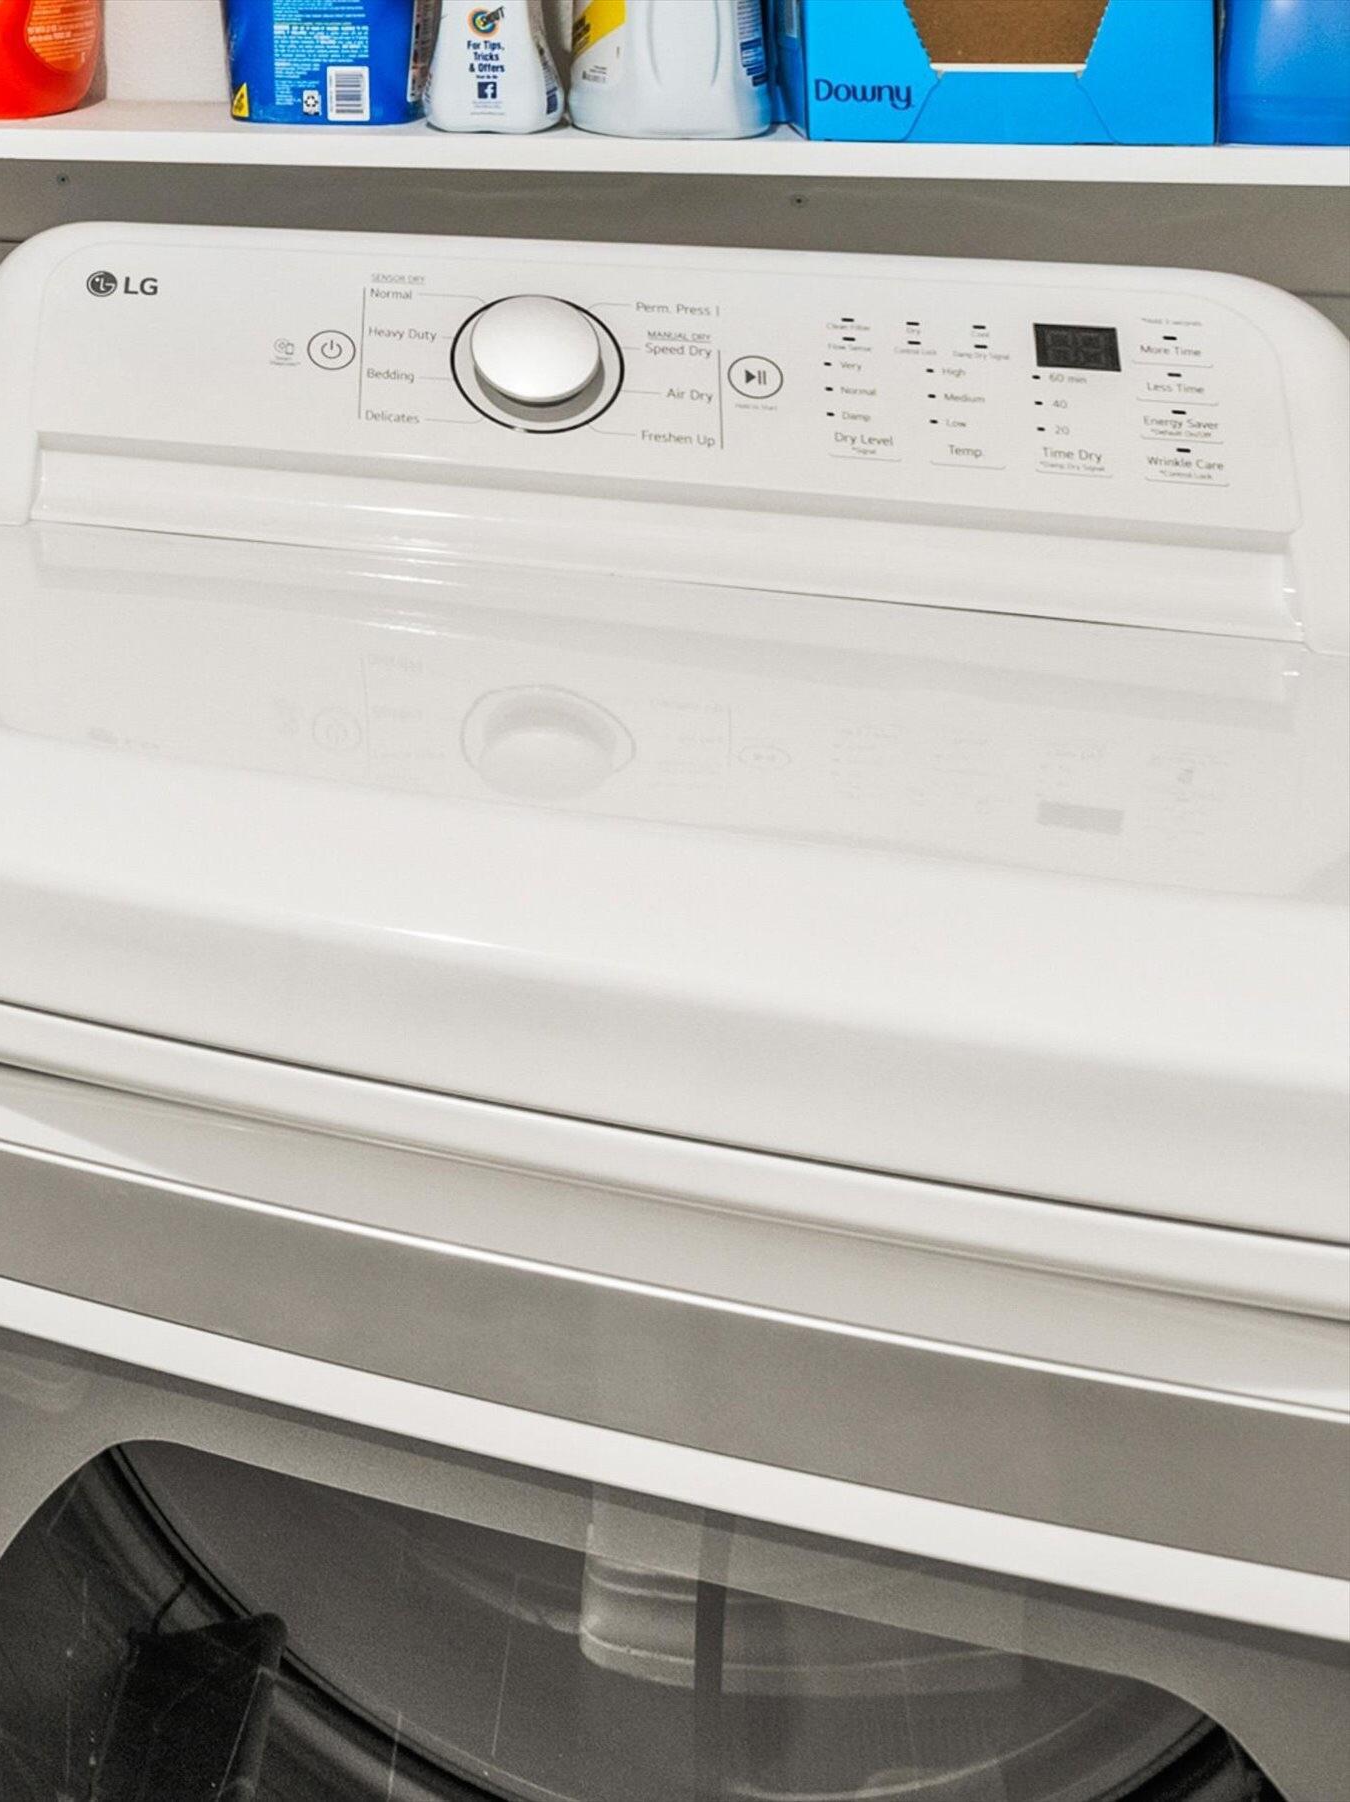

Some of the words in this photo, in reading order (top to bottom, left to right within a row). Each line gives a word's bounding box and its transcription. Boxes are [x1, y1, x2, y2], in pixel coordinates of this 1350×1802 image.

[467, 41, 480, 50] For
[484, 41, 505, 51] Tips,
[473, 52, 499, 61] Tricks
[469, 63, 475, 73] &
[478, 63, 505, 73] Offers
[814, 78, 912, 111] Downy
[123, 276, 159, 296] LG
[408, 275, 425, 285] DRY
[370, 288, 413, 300] Normal
[635, 301, 671, 314] Perm.
[676, 303, 710, 316] Press
[368, 326, 403, 340] Heavy
[408, 328, 437, 342] Duty
[647, 330, 689, 341] MANUAL
[692, 333, 712, 342] DRY
[906, 327, 920, 335] Dry
[645, 342, 684, 356] Speed
[689, 344, 712, 359] Dry
[1140, 345, 1169, 355] More
[1174, 346, 1201, 357] Time
[841, 360, 862, 371] Very
[366, 368, 415, 383] Bedding
[942, 367, 966, 378] High
[1049, 374, 1065, 383] 60
[1067, 375, 1087, 384] min
[841, 386, 877, 396] Normal
[1147, 382, 1173, 393] Less
[1177, 383, 1204, 394] Time
[666, 388, 685, 399] Air
[690, 389, 714, 404] Dry
[944, 393, 986, 404] Medium
[1052, 400, 1068, 409] 40
[365, 410, 420, 424] Delicates
[842, 411, 871, 423] Damp
[946, 418, 967, 428] Low
[1143, 416, 1182, 429] Energy
[1186, 418, 1219, 430] Saver
[1054, 426, 1070, 435] 20
[641, 430, 692, 444] Freshen
[697, 434, 716, 448] Up
[834, 431, 857, 446] Dry
[860, 434, 894, 447] Level
[948, 444, 983, 459] Temp
[1043, 446, 1074, 459] Time
[1078, 449, 1102, 464] Dry
[1147, 456, 1192, 468] Wrinkle
[1196, 459, 1224, 471] Care
